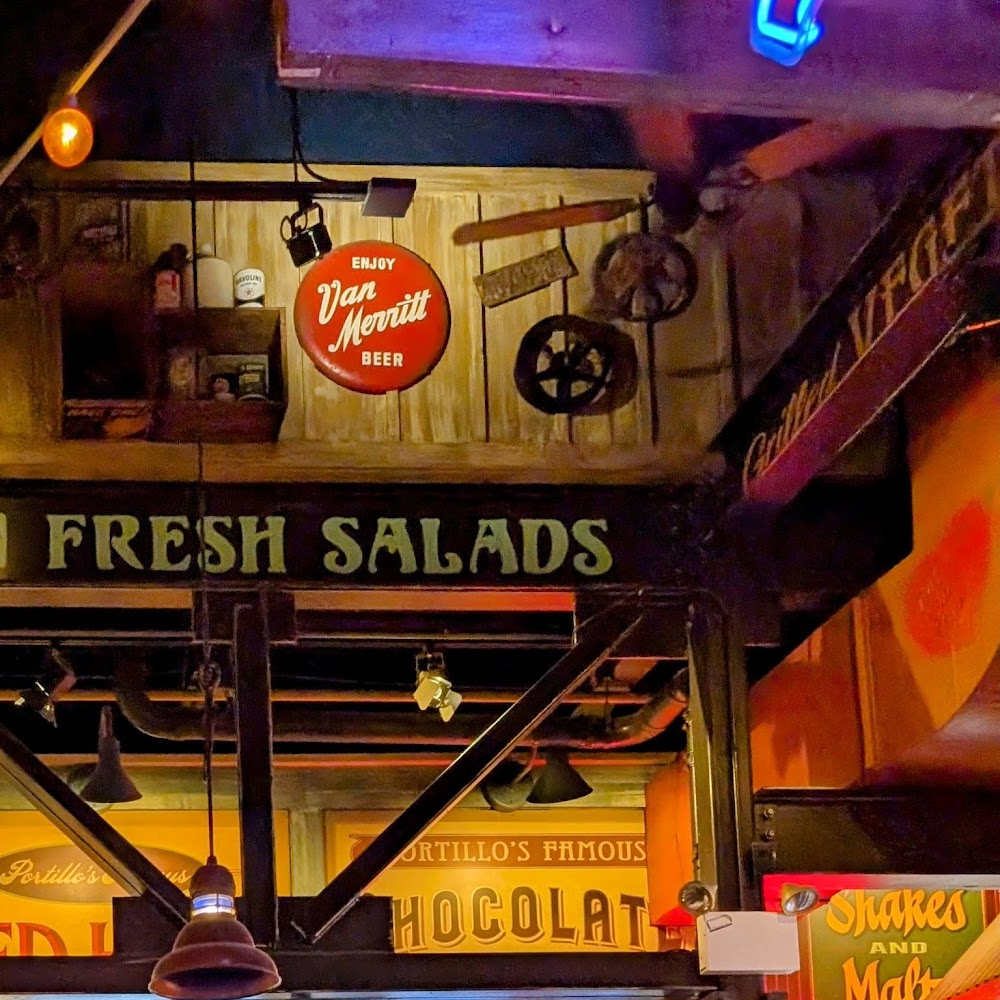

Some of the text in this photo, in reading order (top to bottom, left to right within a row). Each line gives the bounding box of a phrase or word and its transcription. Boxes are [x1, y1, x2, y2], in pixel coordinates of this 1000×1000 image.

[352, 256, 396, 270] ENJOY
[317, 279, 377, 325] Van
[327, 288, 432, 352] Merritt
[361, 351, 404, 367] BEER
[46, 513, 287, 574] FRESH
[321, 516, 614, 576] SALADS
[398, 840, 647, 863] ORTILLO'S FAMOUS
[0, 856, 101, 887] Portillo's
[393, 886, 652, 952] HOCOLAT
[869, 941, 928, 955] AND
